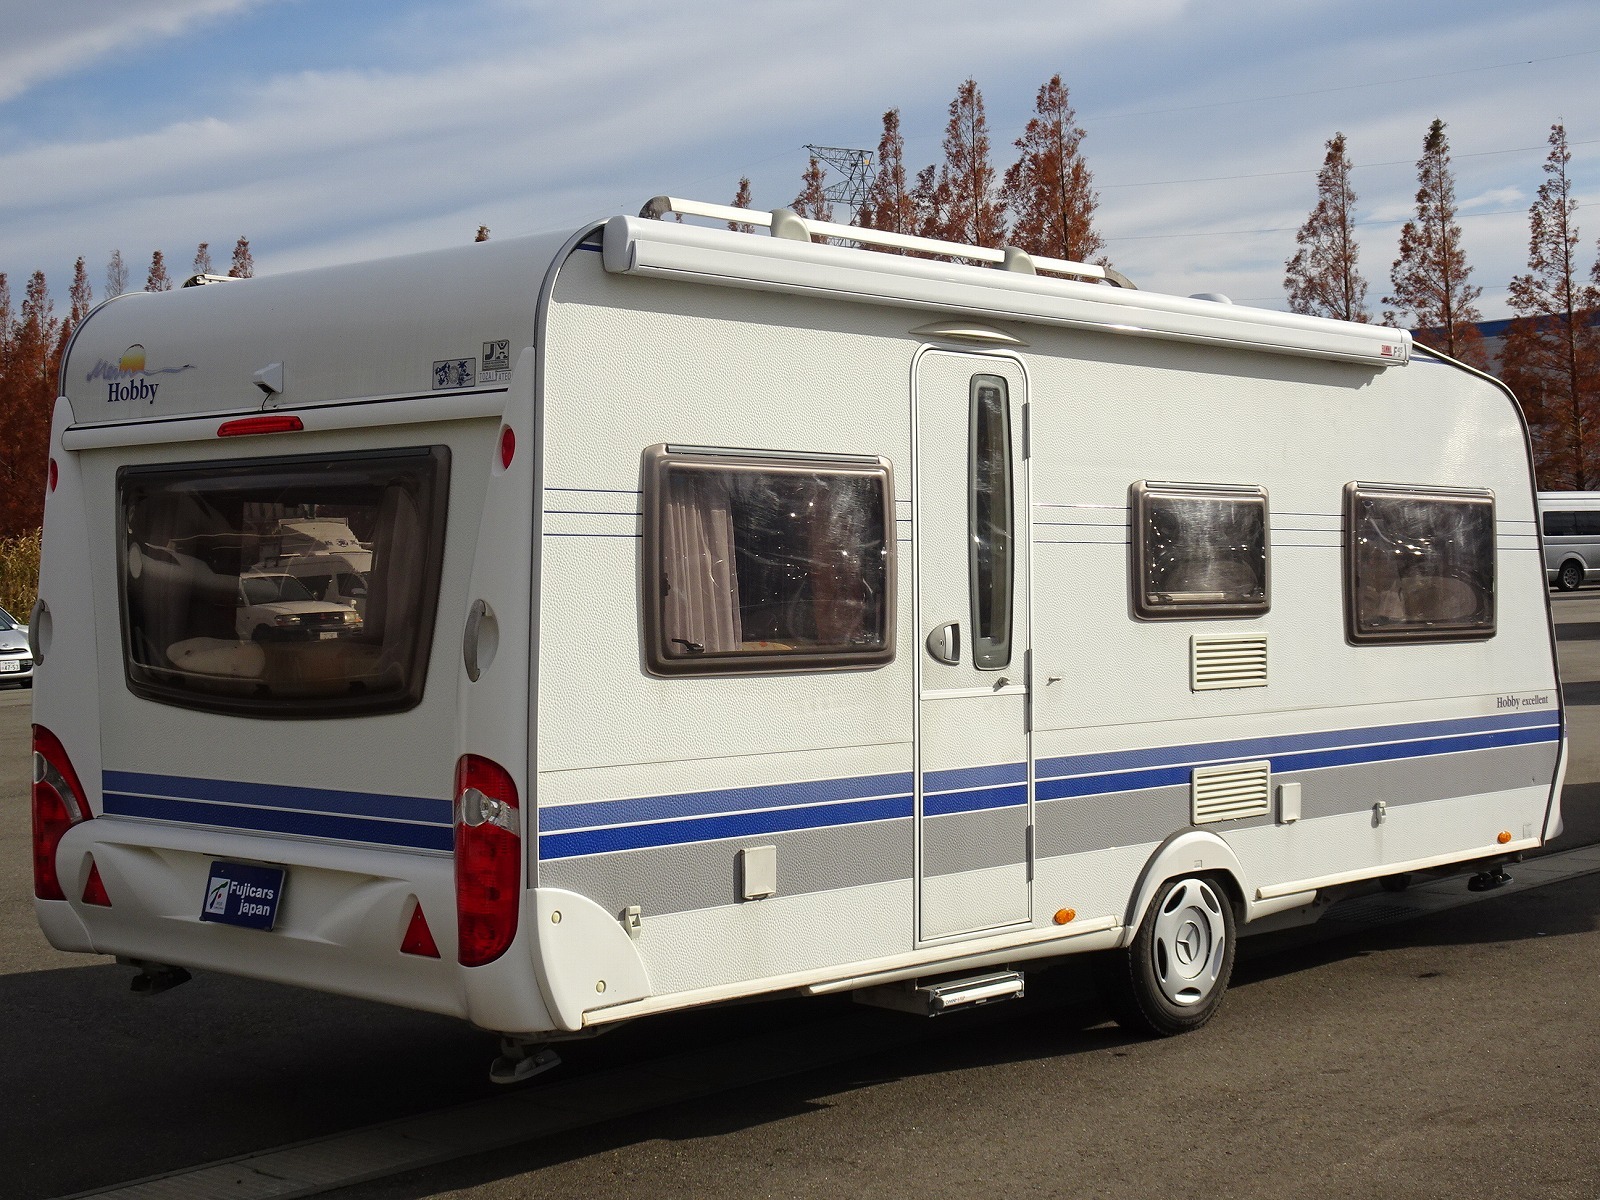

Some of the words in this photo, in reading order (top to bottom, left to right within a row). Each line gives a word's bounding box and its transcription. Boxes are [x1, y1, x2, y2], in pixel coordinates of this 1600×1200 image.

[107, 378, 160, 405] Hobby
[1496, 694, 1520, 710] Hobby
[1521, 694, 1549, 706] excellent
[229, 881, 274, 900] Fujicars
[237, 899, 271, 917] japan
